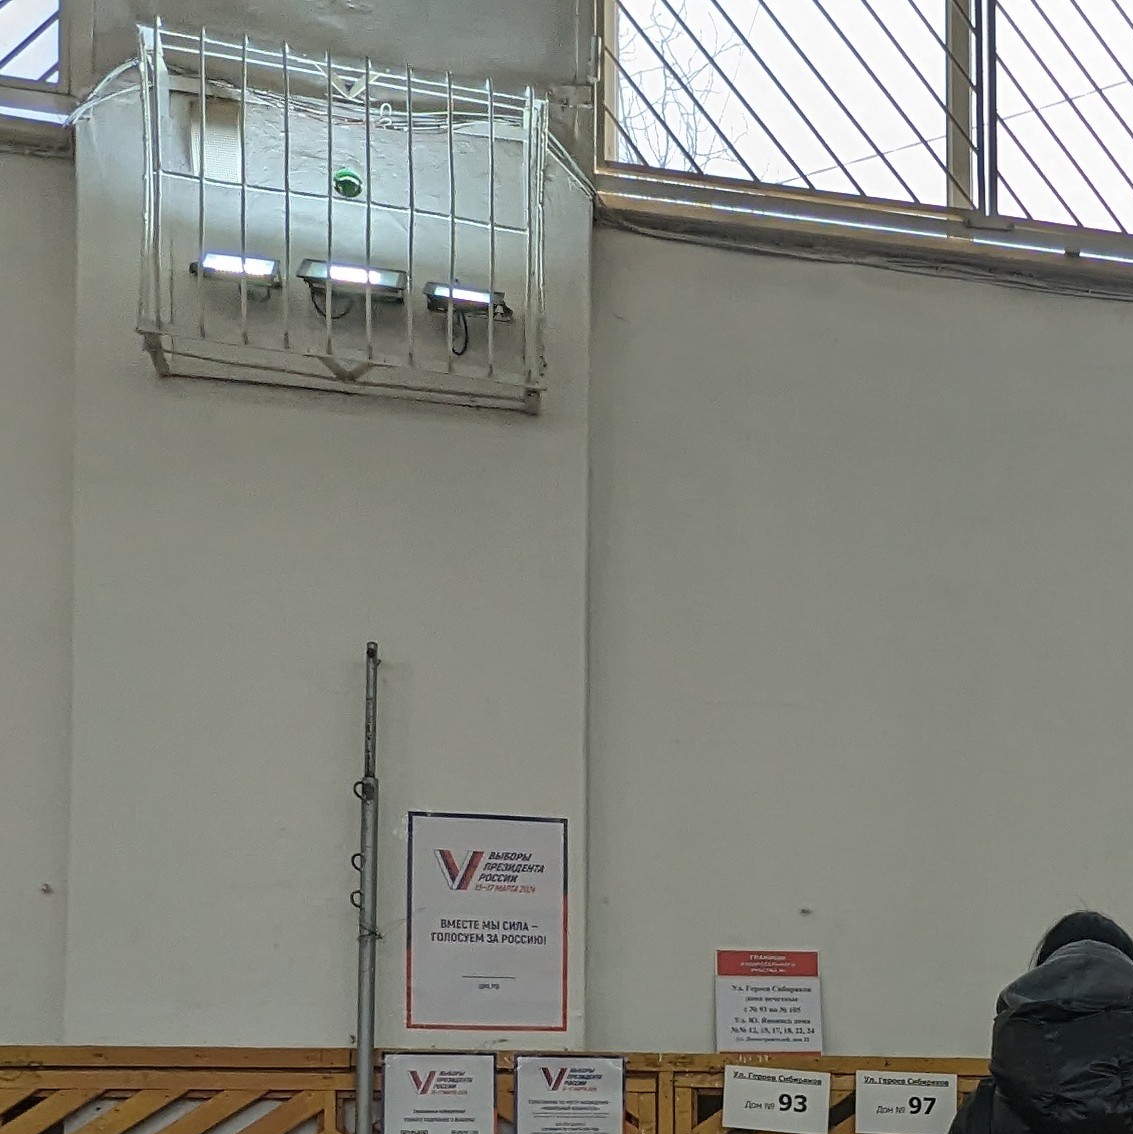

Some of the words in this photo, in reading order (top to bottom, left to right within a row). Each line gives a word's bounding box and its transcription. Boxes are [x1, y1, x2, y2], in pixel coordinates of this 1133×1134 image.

[488, 851, 533, 862] ВЫБОРЫ
[483, 862, 546, 873] ПРЕЗИДЕНТА
[478, 873, 519, 883] РОССИИ
[440, 919, 480, 930] ВМЕСТЕ
[482, 920, 500, 930] МЫ
[502, 921, 529, 931] СИЛА
[431, 932, 484, 943] ГОЛОСУЕМ
[486, 933, 499, 943] ЗА
[501, 934, 547, 945] РОССИЮ!
[733, 1071, 747, 1079] Ул.
[748, 1072, 777, 1082] Героев
[863, 1075, 877, 1084] Ул.
[879, 1077, 906, 1085] Героев
[744, 1100, 763, 1109] Дом
[764, 1102, 776, 1110] №
[778, 1093, 807, 1113] 93
[876, 1105, 894, 1114] Дом
[895, 1106, 906, 1114] №
[908, 1096, 936, 1115] 97
